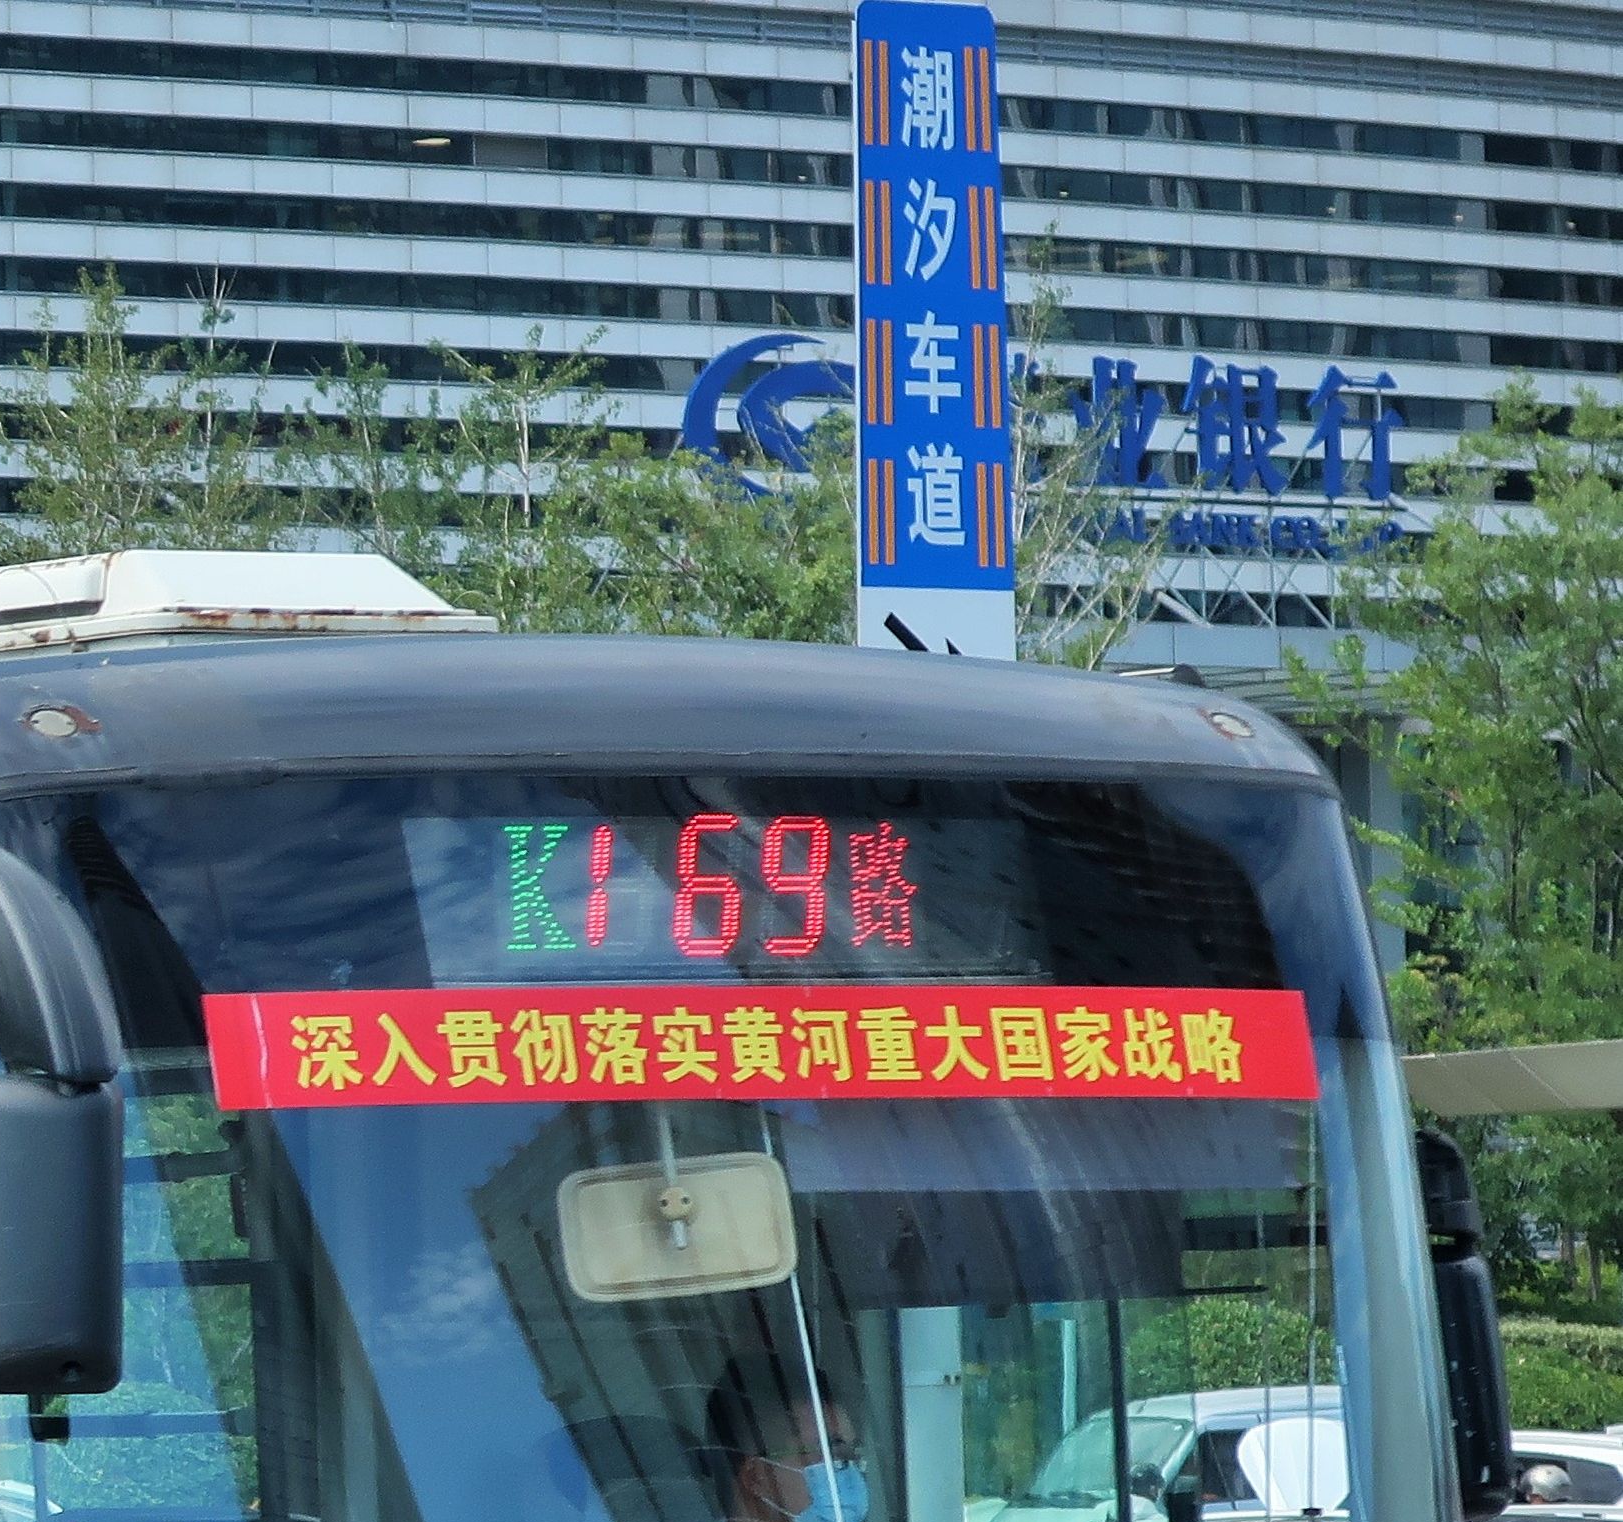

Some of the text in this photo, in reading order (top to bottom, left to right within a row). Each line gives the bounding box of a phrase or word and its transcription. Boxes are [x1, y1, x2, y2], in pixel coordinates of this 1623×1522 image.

[902, 47, 966, 546] 潮汐车道
[1015, 354, 1405, 500] 业银行
[290, 1005, 1243, 1091] 深入贯彻落实黄河重大国家战略
